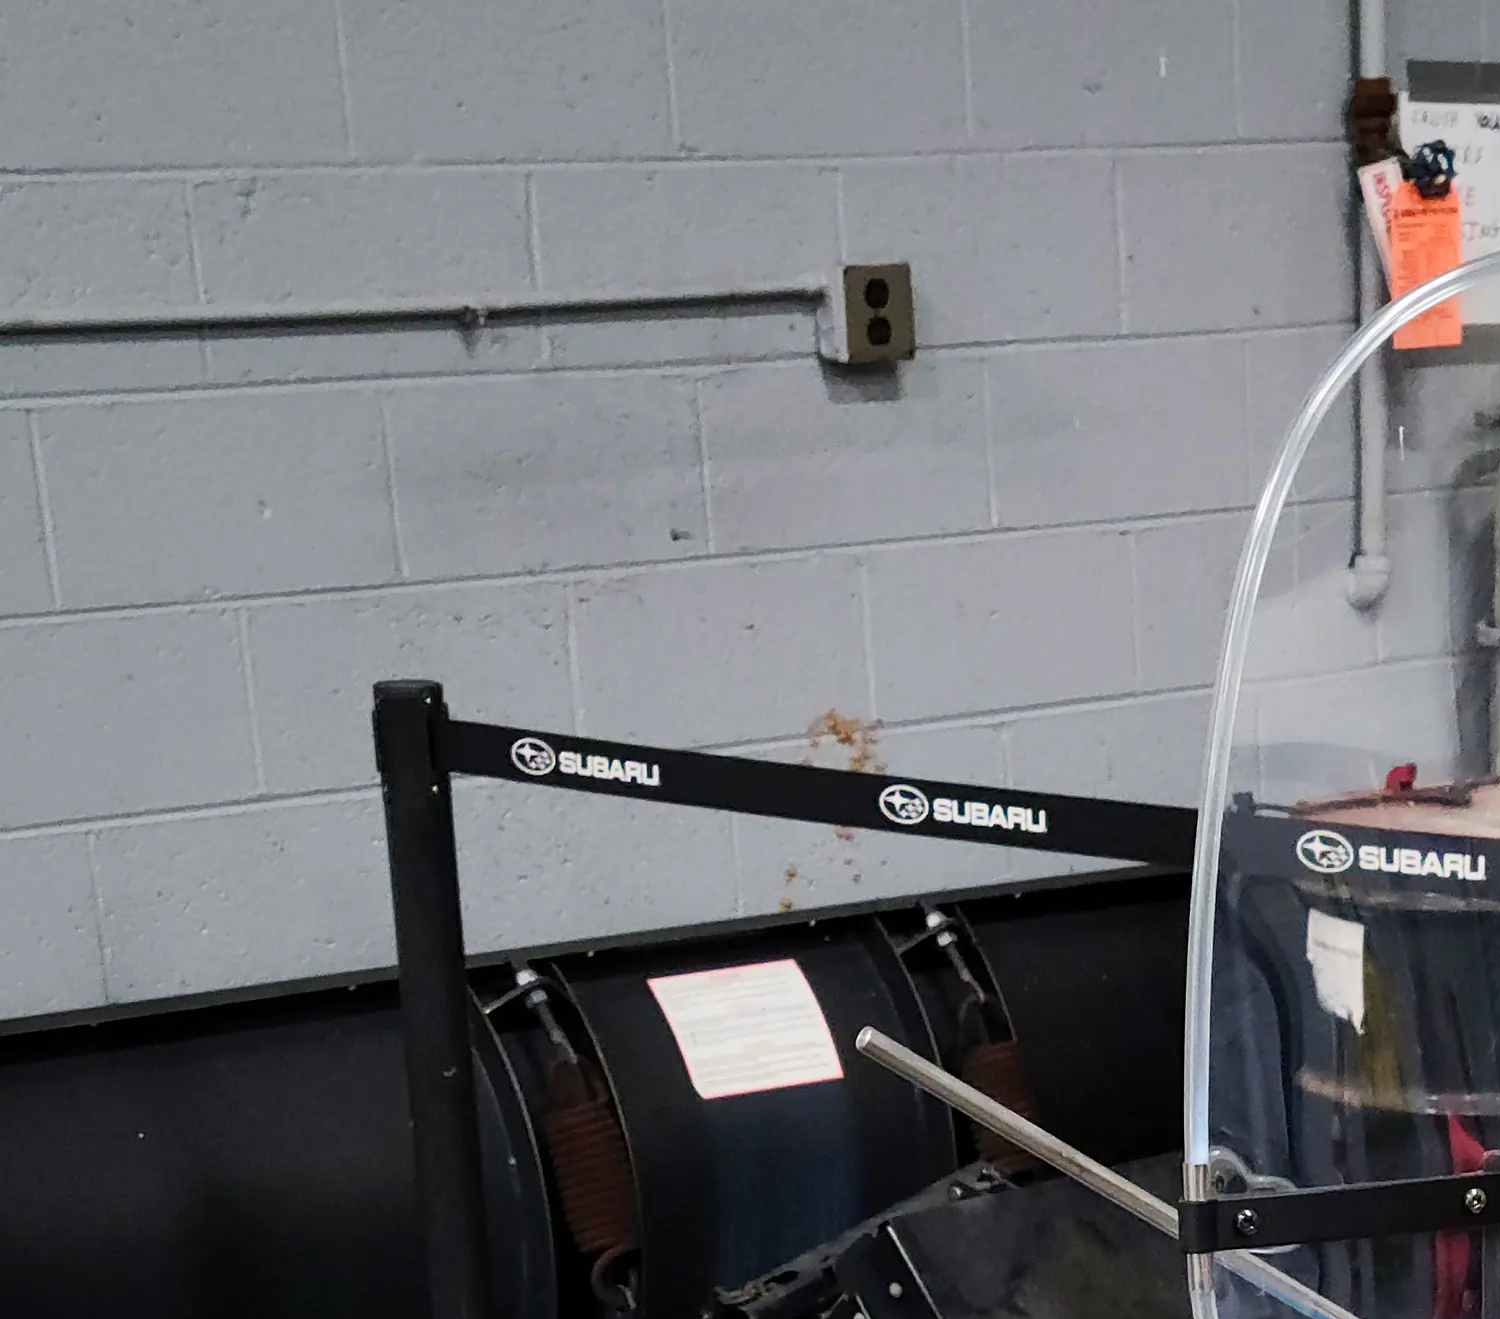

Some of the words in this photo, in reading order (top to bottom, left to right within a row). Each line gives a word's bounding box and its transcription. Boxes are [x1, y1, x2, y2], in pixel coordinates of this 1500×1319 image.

[558, 751, 661, 786] SUBARU
[932, 798, 1048, 834] SUBARU
[1358, 845, 1487, 881] SUBARU
